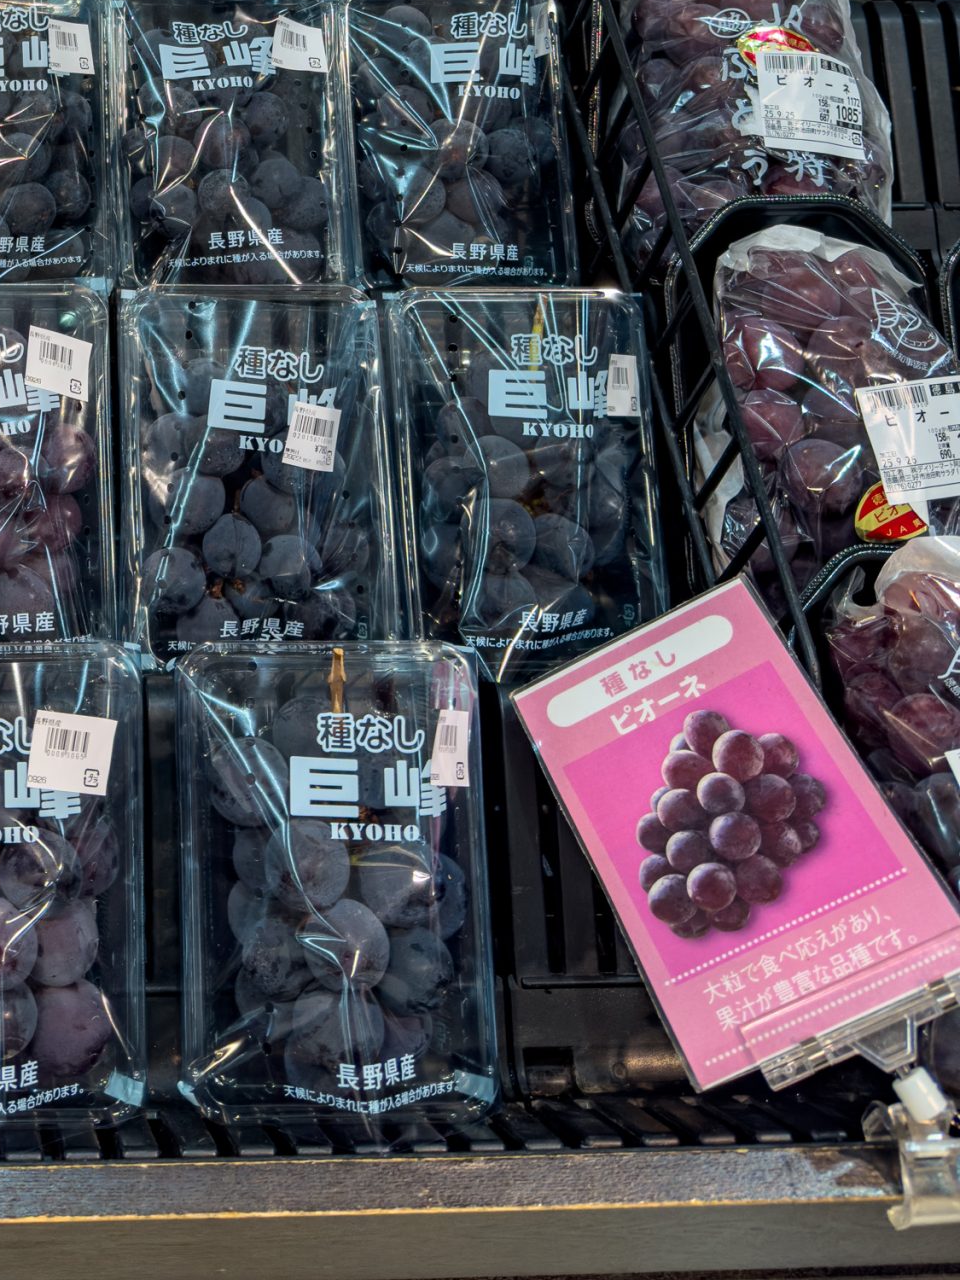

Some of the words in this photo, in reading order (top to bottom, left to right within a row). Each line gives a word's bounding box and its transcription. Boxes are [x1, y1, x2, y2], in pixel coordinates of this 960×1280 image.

[173, 20, 248, 44] 種なし
[451, 12, 528, 40] 種なし
[158, 36, 277, 80] 巨峰
[430, 41, 537, 86] 巨峰
[191, 77, 254, 92] KYOHO
[458, 84, 521, 100] KYOHO
[836, 105, 859, 123] 1085
[208, 228, 284, 250] 長野県産
[451, 243, 519, 261] 長野県産
[511, 333, 598, 366] 種なし
[234, 345, 324, 383] 種なし
[930, 381, 960, 397] 徳島
[522, 422, 594, 439] KYOHO
[239, 436, 285, 453] KYO
[220, 618, 305, 639] 長野県産
[518, 608, 588, 633] 長野県産
[599, 649, 678, 700] 種なし
[610, 675, 707, 736] ピオーネ
[316, 712, 425, 754] 種なし
[330, 822, 419, 842] KYOHO
[703, 905, 892, 1005] 大粒で食べ応えがあり、
[715, 928, 918, 1032] 果汁が豊富な品種です。
[337, 1053, 417, 1091] 長野県産
